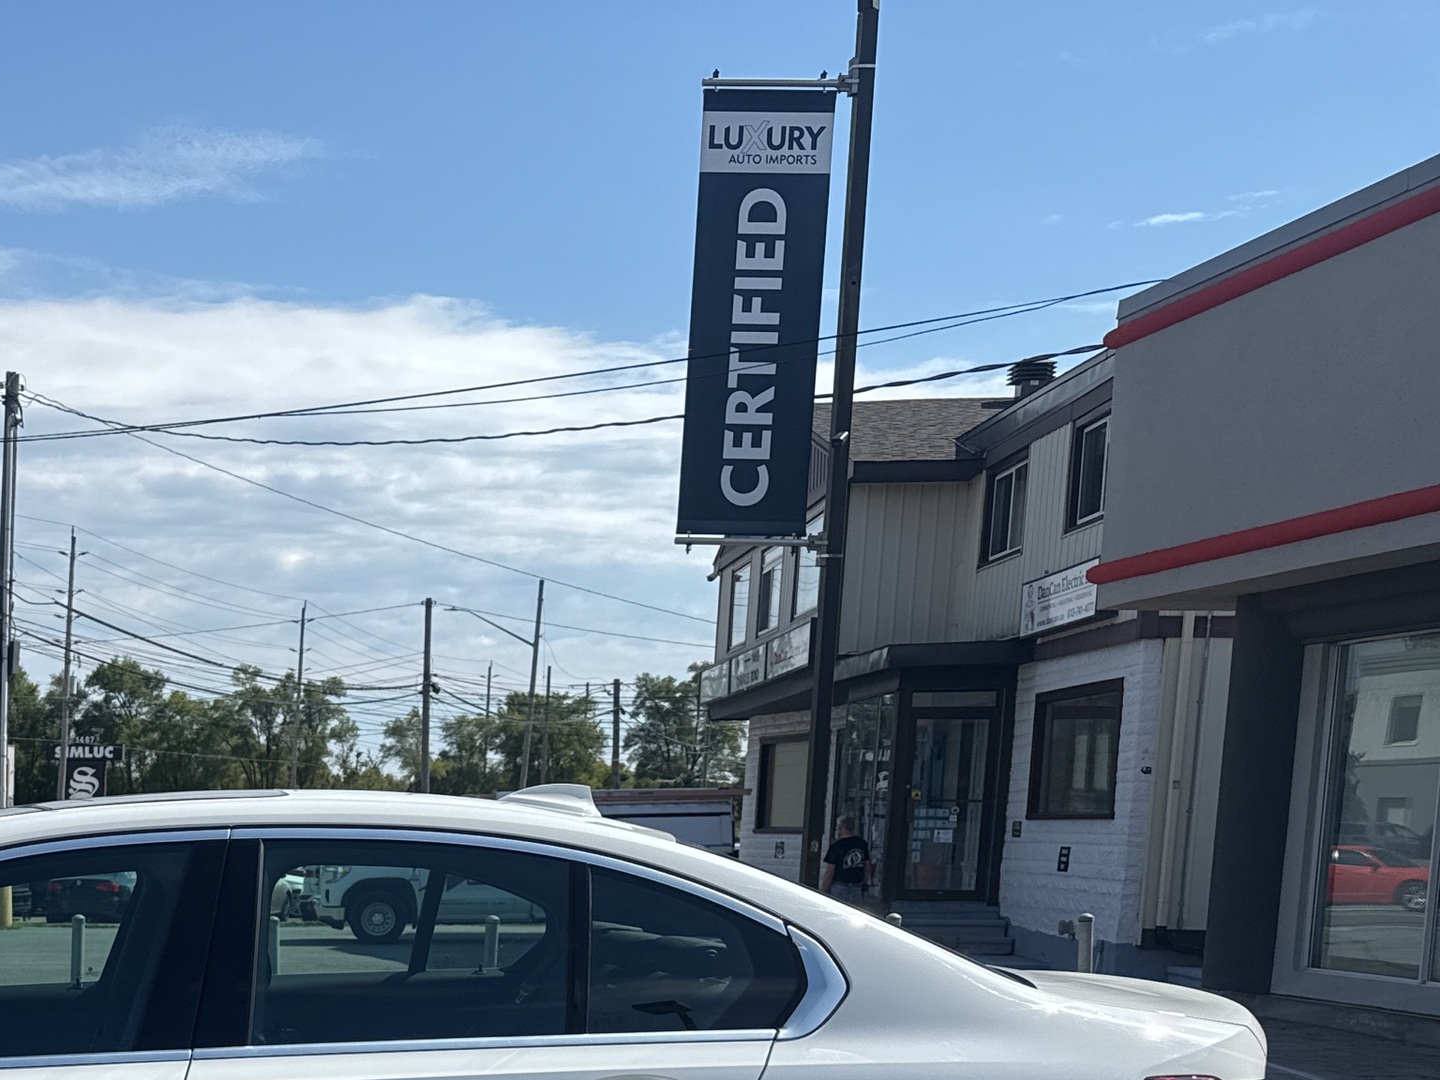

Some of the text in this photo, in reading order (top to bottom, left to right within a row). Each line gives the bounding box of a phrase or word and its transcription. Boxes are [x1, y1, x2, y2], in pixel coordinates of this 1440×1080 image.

[708, 120, 827, 154] LUXURY
[728, 154, 817, 165] AUTO IMPORTS
[720, 188, 787, 507] CERTIFIED
